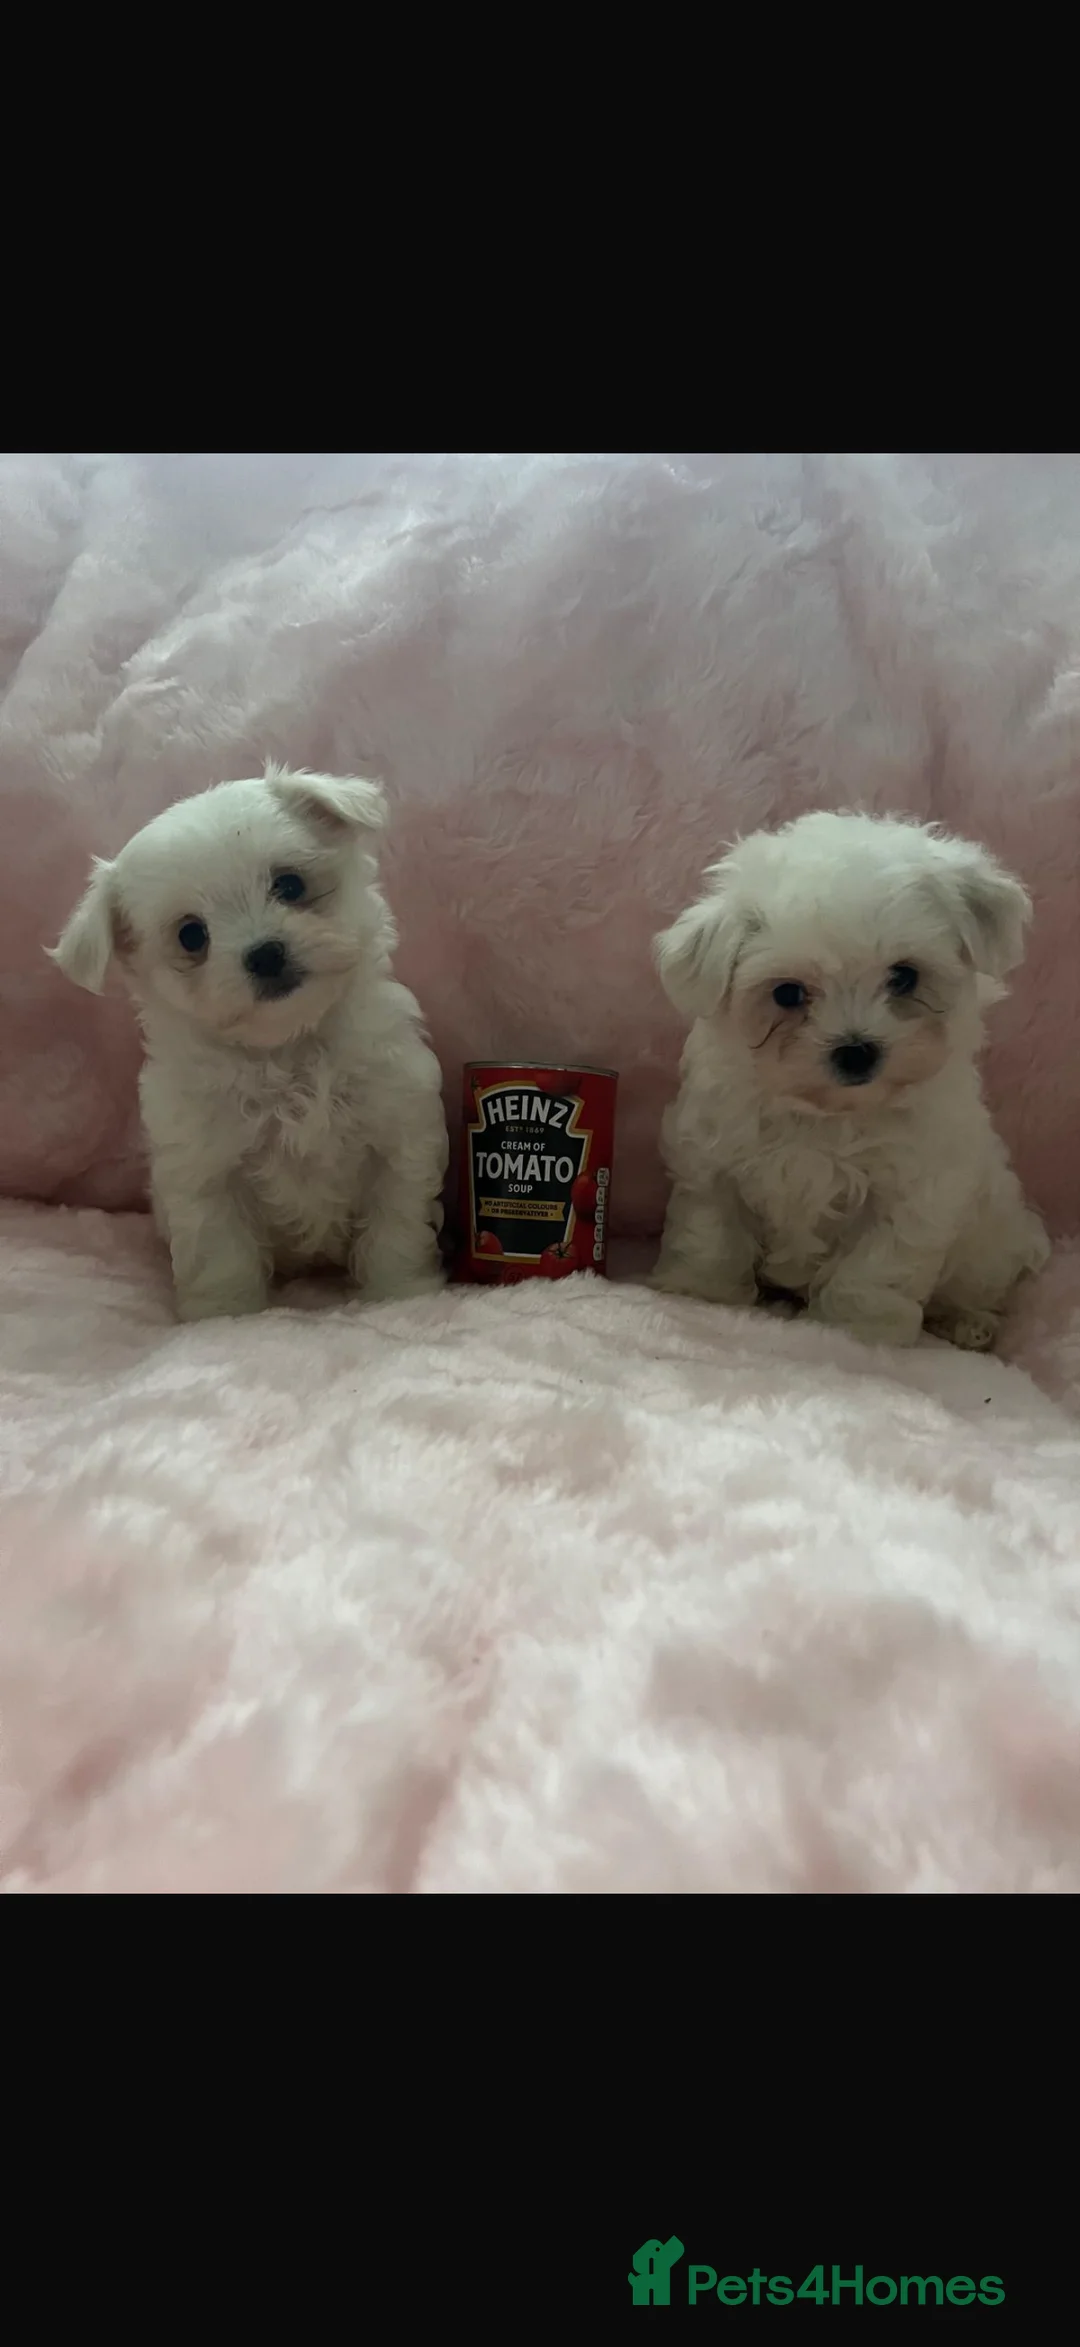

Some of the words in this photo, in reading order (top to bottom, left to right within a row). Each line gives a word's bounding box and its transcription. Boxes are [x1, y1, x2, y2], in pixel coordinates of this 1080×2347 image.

[487, 1095, 568, 1129] HEINZ
[525, 1126, 545, 1134] 1869
[501, 1140, 531, 1151] CREAM
[533, 1142, 546, 1152] OF
[476, 1152, 574, 1183] TOMATO
[508, 1183, 533, 1193] SOUP
[484, 1199, 492, 1207] NO
[492, 1200, 527, 1209] ARTIFICIAL
[527, 1202, 558, 1211] COLOURS
[500, 1208, 549, 1217] PRESERVATIVES
